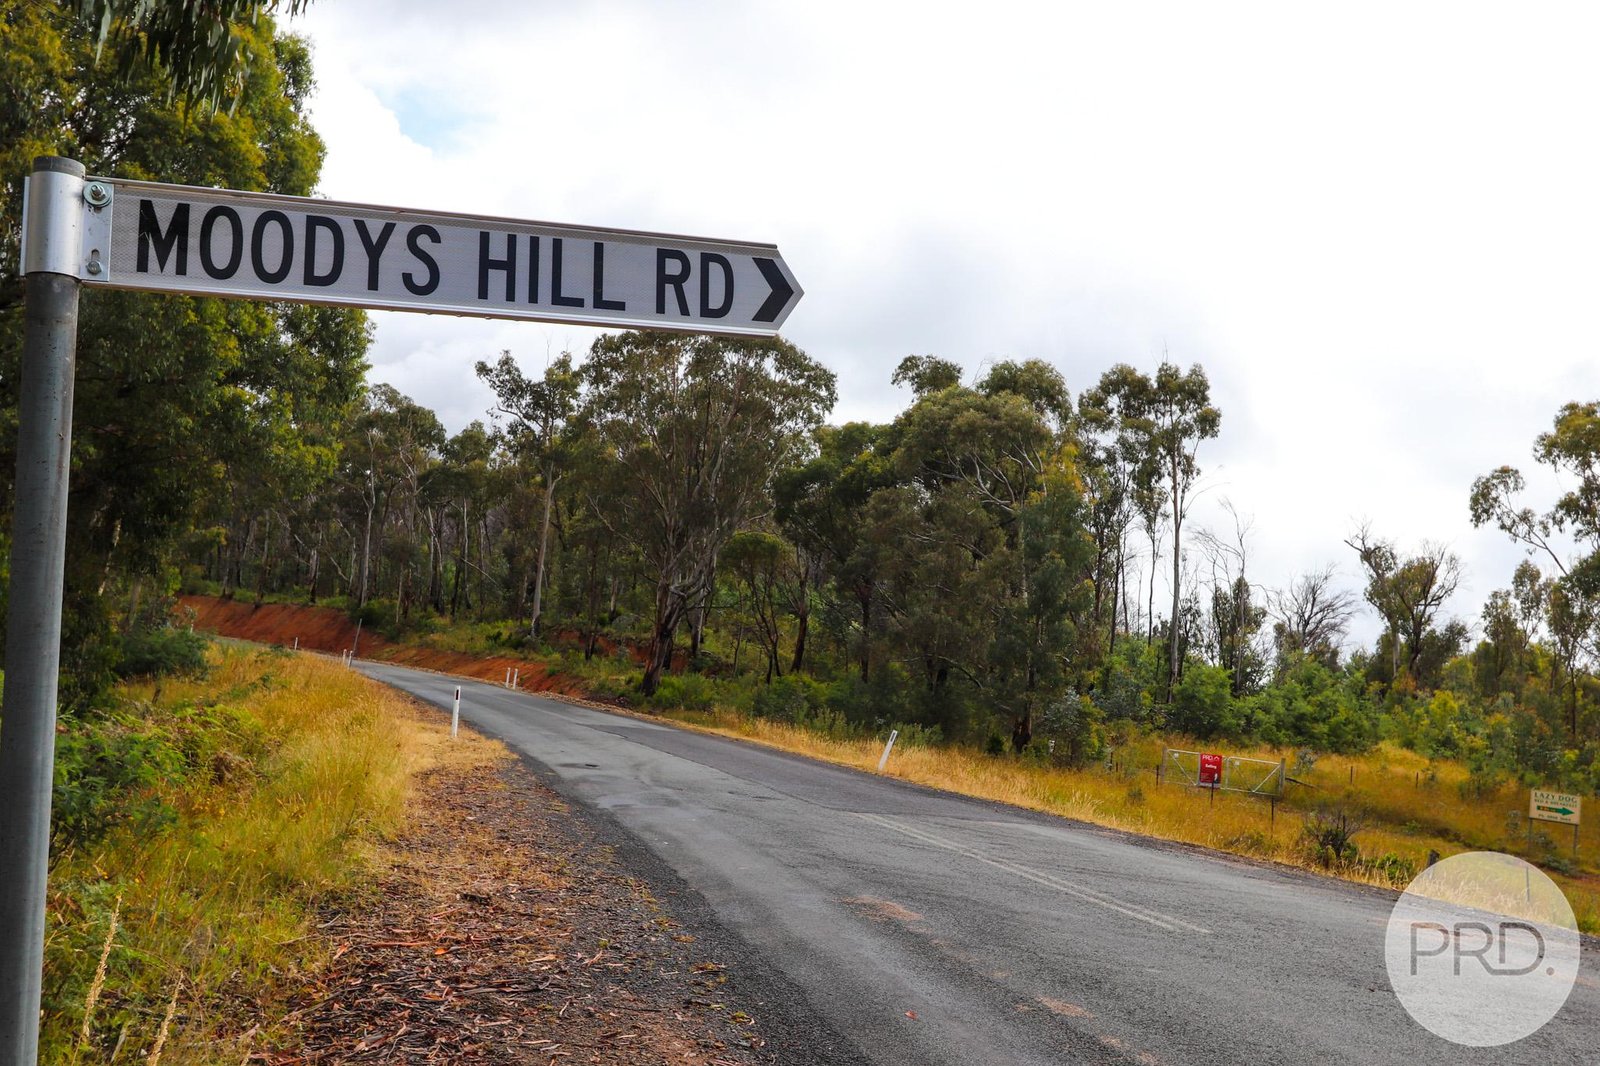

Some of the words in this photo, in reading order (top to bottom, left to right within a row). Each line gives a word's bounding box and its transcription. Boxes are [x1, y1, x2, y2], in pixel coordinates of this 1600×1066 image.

[137, 199, 441, 296] MOODYS
[478, 231, 625, 311] HILL
[656, 248, 734, 318] RD
[1534, 791, 1555, 800] LAZY
[1558, 795, 1577, 803] DOG
